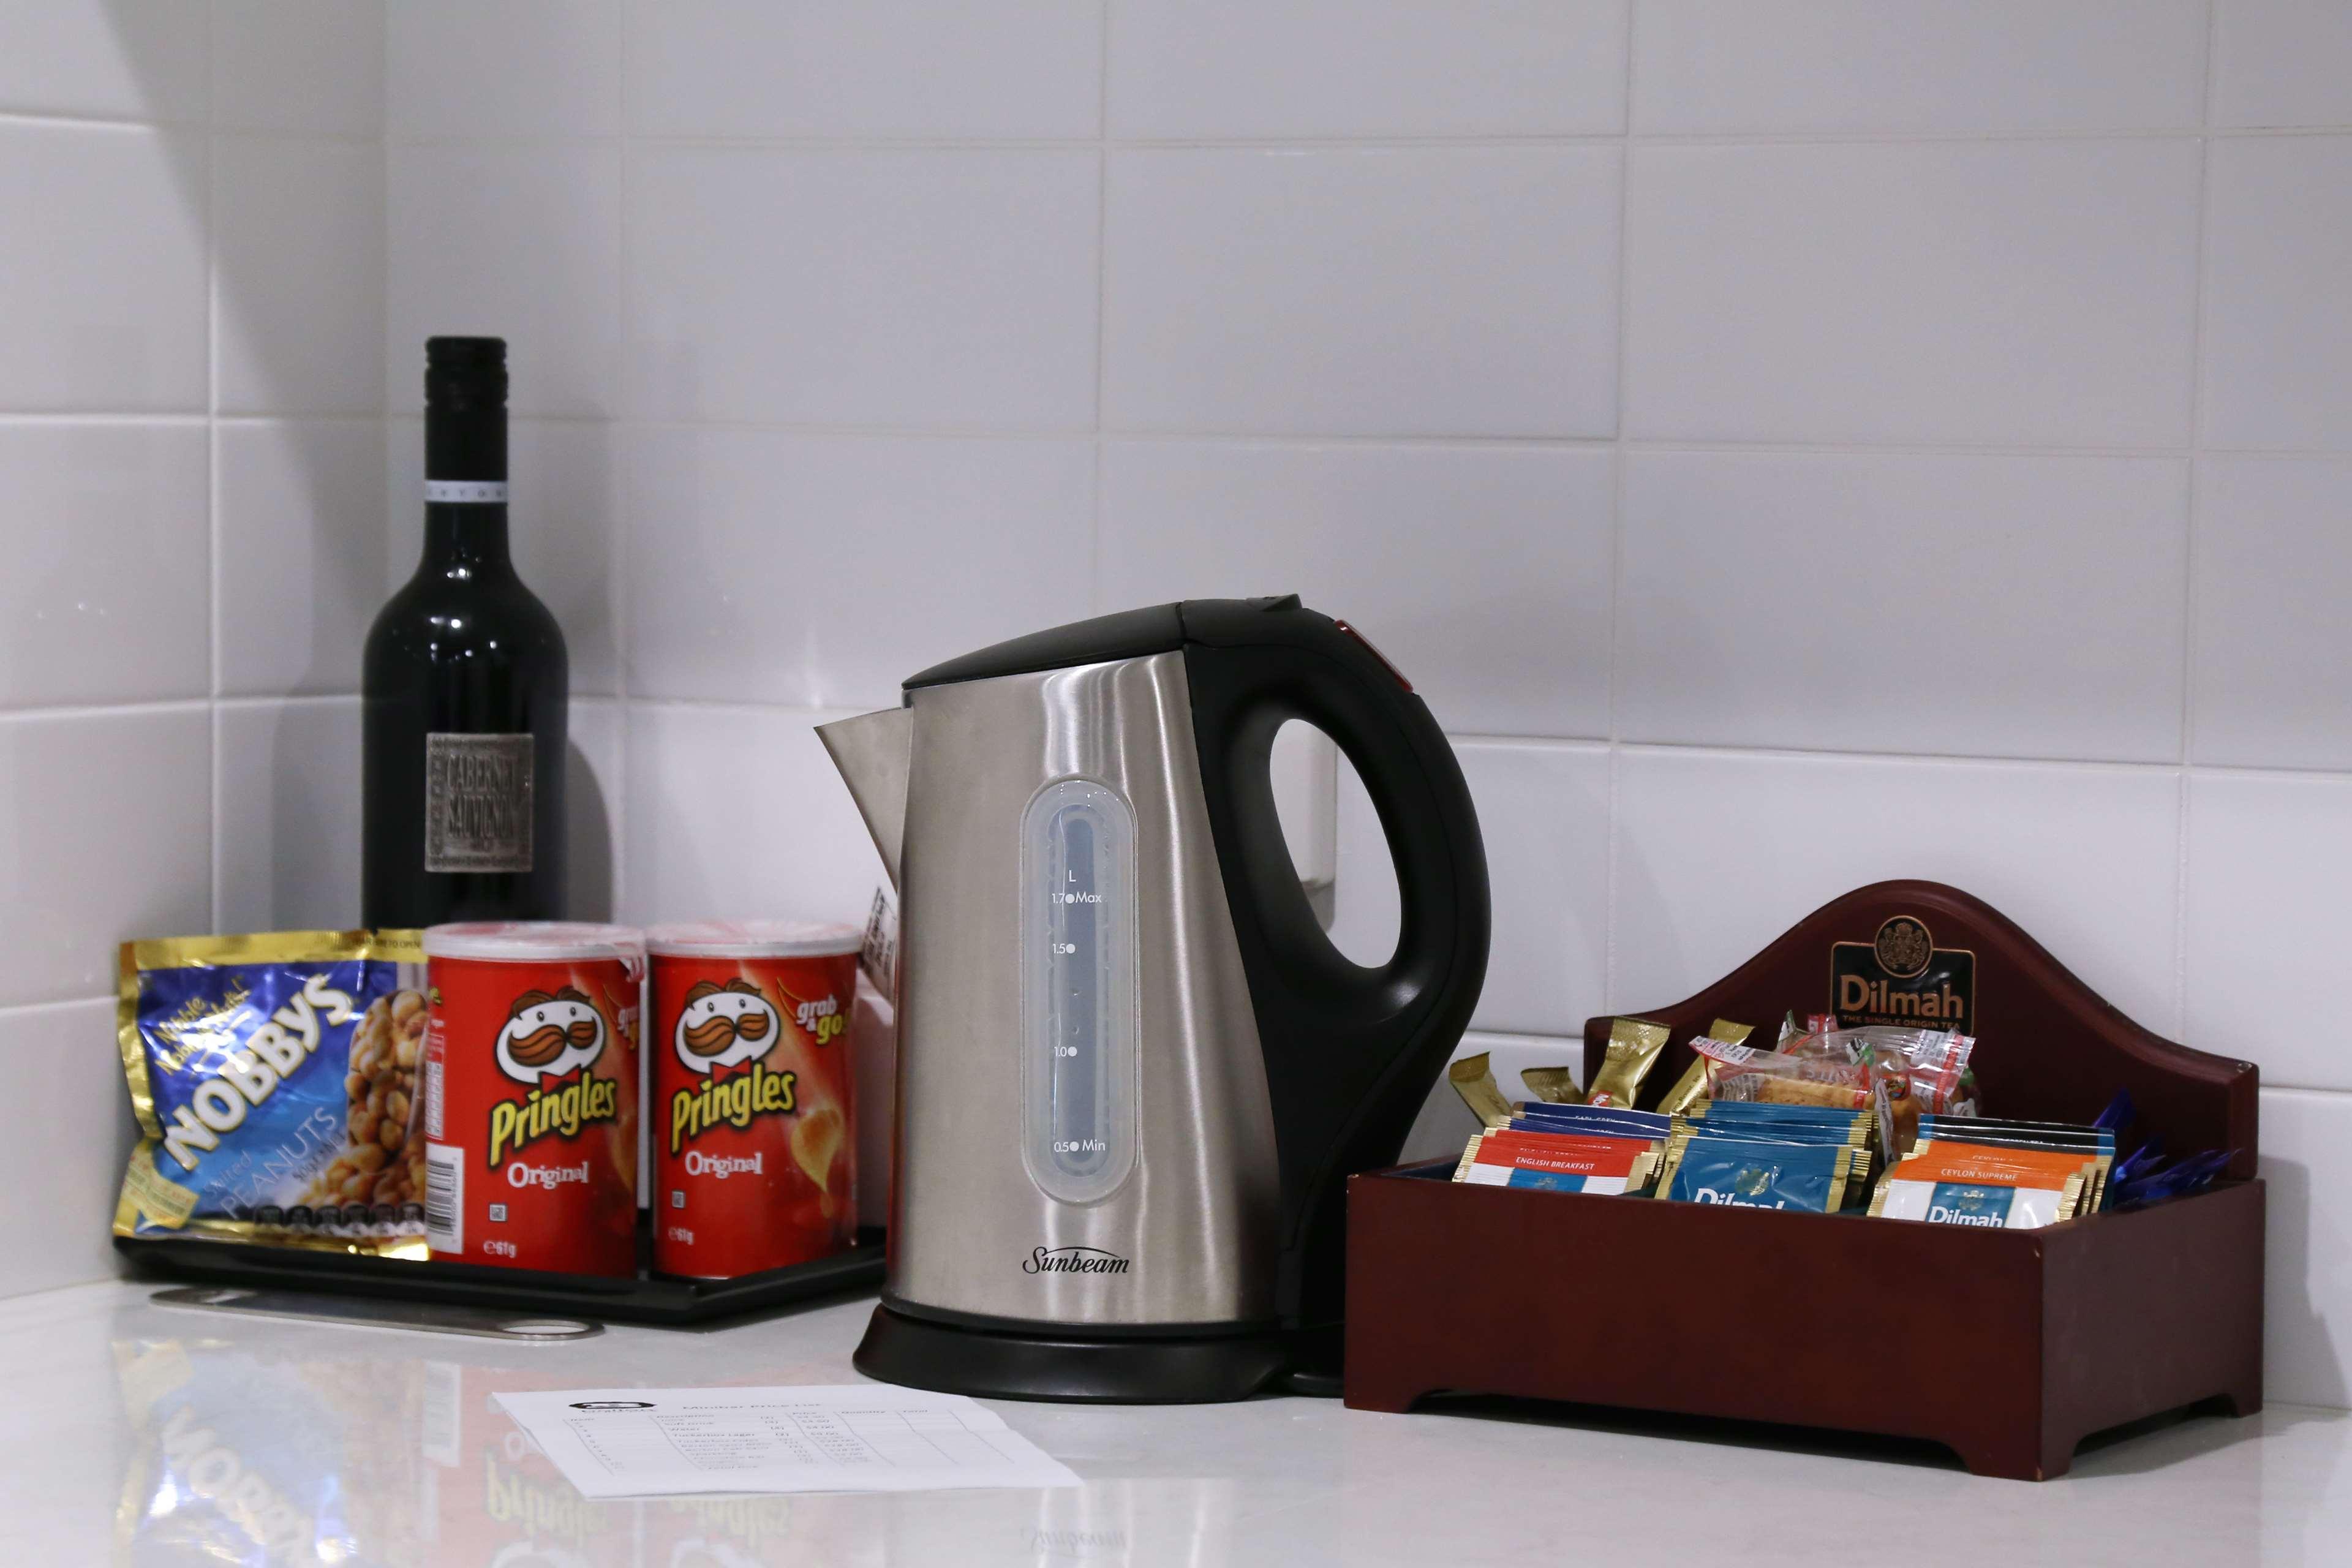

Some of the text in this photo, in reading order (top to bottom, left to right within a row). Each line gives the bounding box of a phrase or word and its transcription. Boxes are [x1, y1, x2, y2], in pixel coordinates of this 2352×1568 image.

[1069, 870, 1076, 882] L
[1076, 892, 1102, 903] Max
[1052, 944, 1066, 954] 1.5
[1839, 974, 1964, 1019] Dilmah
[796, 993, 837, 1025] grab
[1864, 1016, 1902, 1026] SINGLE
[1903, 1019, 1939, 1029] ORIGIN
[1941, 1022, 1961, 1030] TEA
[1054, 1047, 1066, 1057] 1.0
[491, 1072, 616, 1169] Pringles
[671, 1065, 796, 1155] Pringles
[1054, 1139, 1106, 1152] 0.5 Min
[221, 1107, 338, 1220] PEANUTS
[685, 1150, 763, 1178] Original
[1516, 1156, 1596, 1170] ENGLISH BREAKFAST
[508, 1161, 589, 1189] Original
[1940, 1168, 2019, 1181] CEYLON SUPREME
[1929, 1205, 2003, 1227] Dilmah
[1022, 1246, 1129, 1275] Sunbeam
